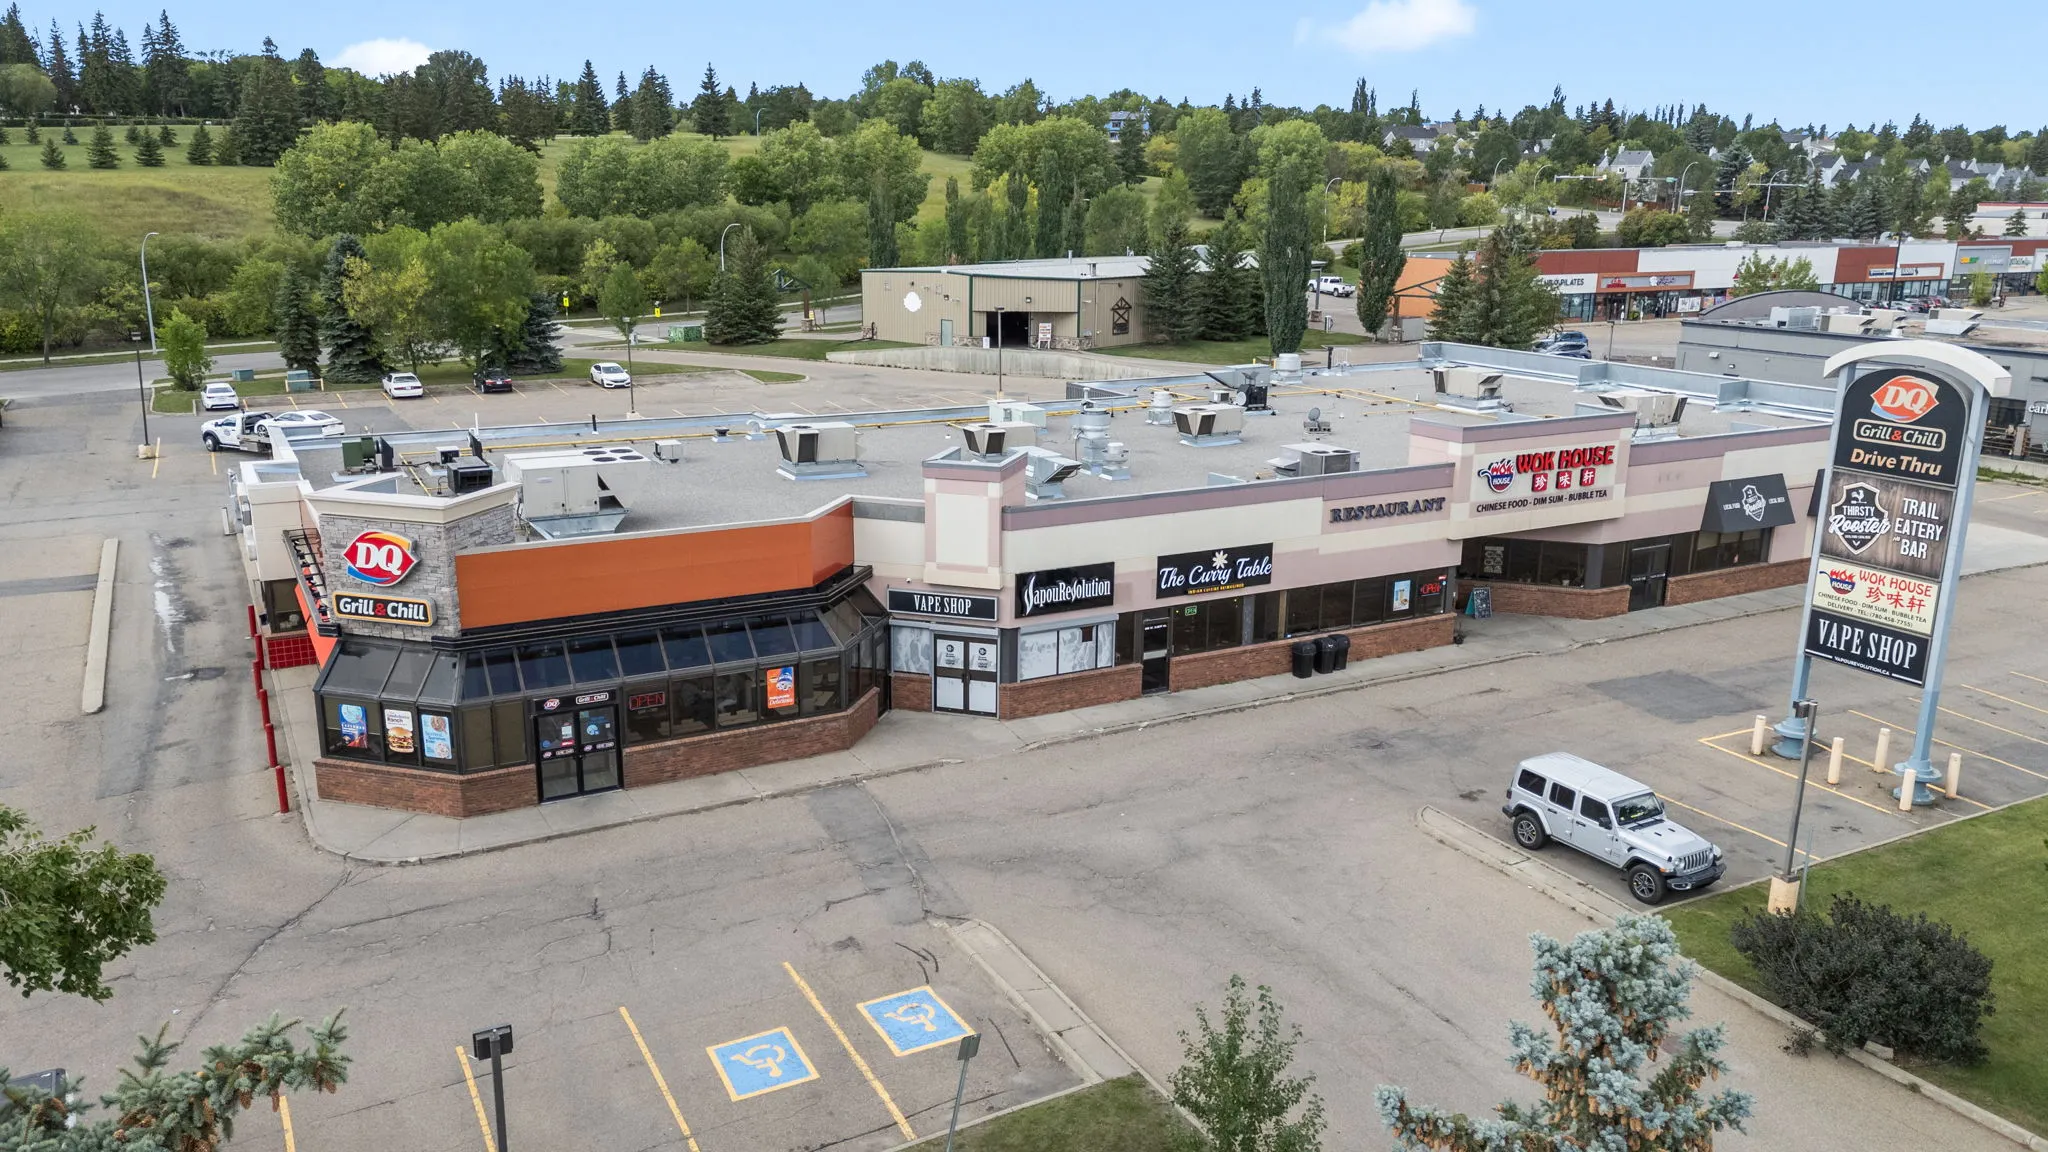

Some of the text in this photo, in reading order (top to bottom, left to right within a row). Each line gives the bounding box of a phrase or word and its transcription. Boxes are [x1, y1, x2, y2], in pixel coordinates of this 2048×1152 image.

[1881, 385, 1928, 414] DQ
[1516, 445, 1615, 474] WOK HOUSE
[1850, 448, 1943, 476] Drive Thru
[1492, 477, 1511, 485] HOUSE
[1535, 470, 1594, 490] 珍味轩
[1329, 497, 1446, 523] RESTAURANT
[1476, 489, 1607, 512] CHINESE FOOD DIM SUM BUBBLE TEA
[1842, 505, 1875, 516] THIRSTY
[1903, 497, 1940, 520] TRAIL
[1828, 514, 1891, 536] Rooster
[1894, 517, 1944, 541] EATERY
[356, 542, 403, 576] DQ
[1900, 539, 1928, 559] BAR
[1160, 556, 1272, 589] The Curry Table
[1829, 569, 1855, 582] WOK
[1859, 569, 1933, 597] WOK HOUSE
[1831, 581, 1852, 591] HOUSE
[914, 595, 972, 615] VAPE SHOP
[1818, 592, 1841, 601] CHINESE
[1841, 597, 1858, 606] FOOD
[1874, 605, 1888, 613] SUM
[1891, 610, 1914, 620] BUBBLE
[1827, 601, 1854, 612] DELIVERY
[1866, 586, 1926, 614] 珍味轩
[1819, 618, 1918, 669] VAPE SHOP
[631, 693, 663, 709] OPEN
